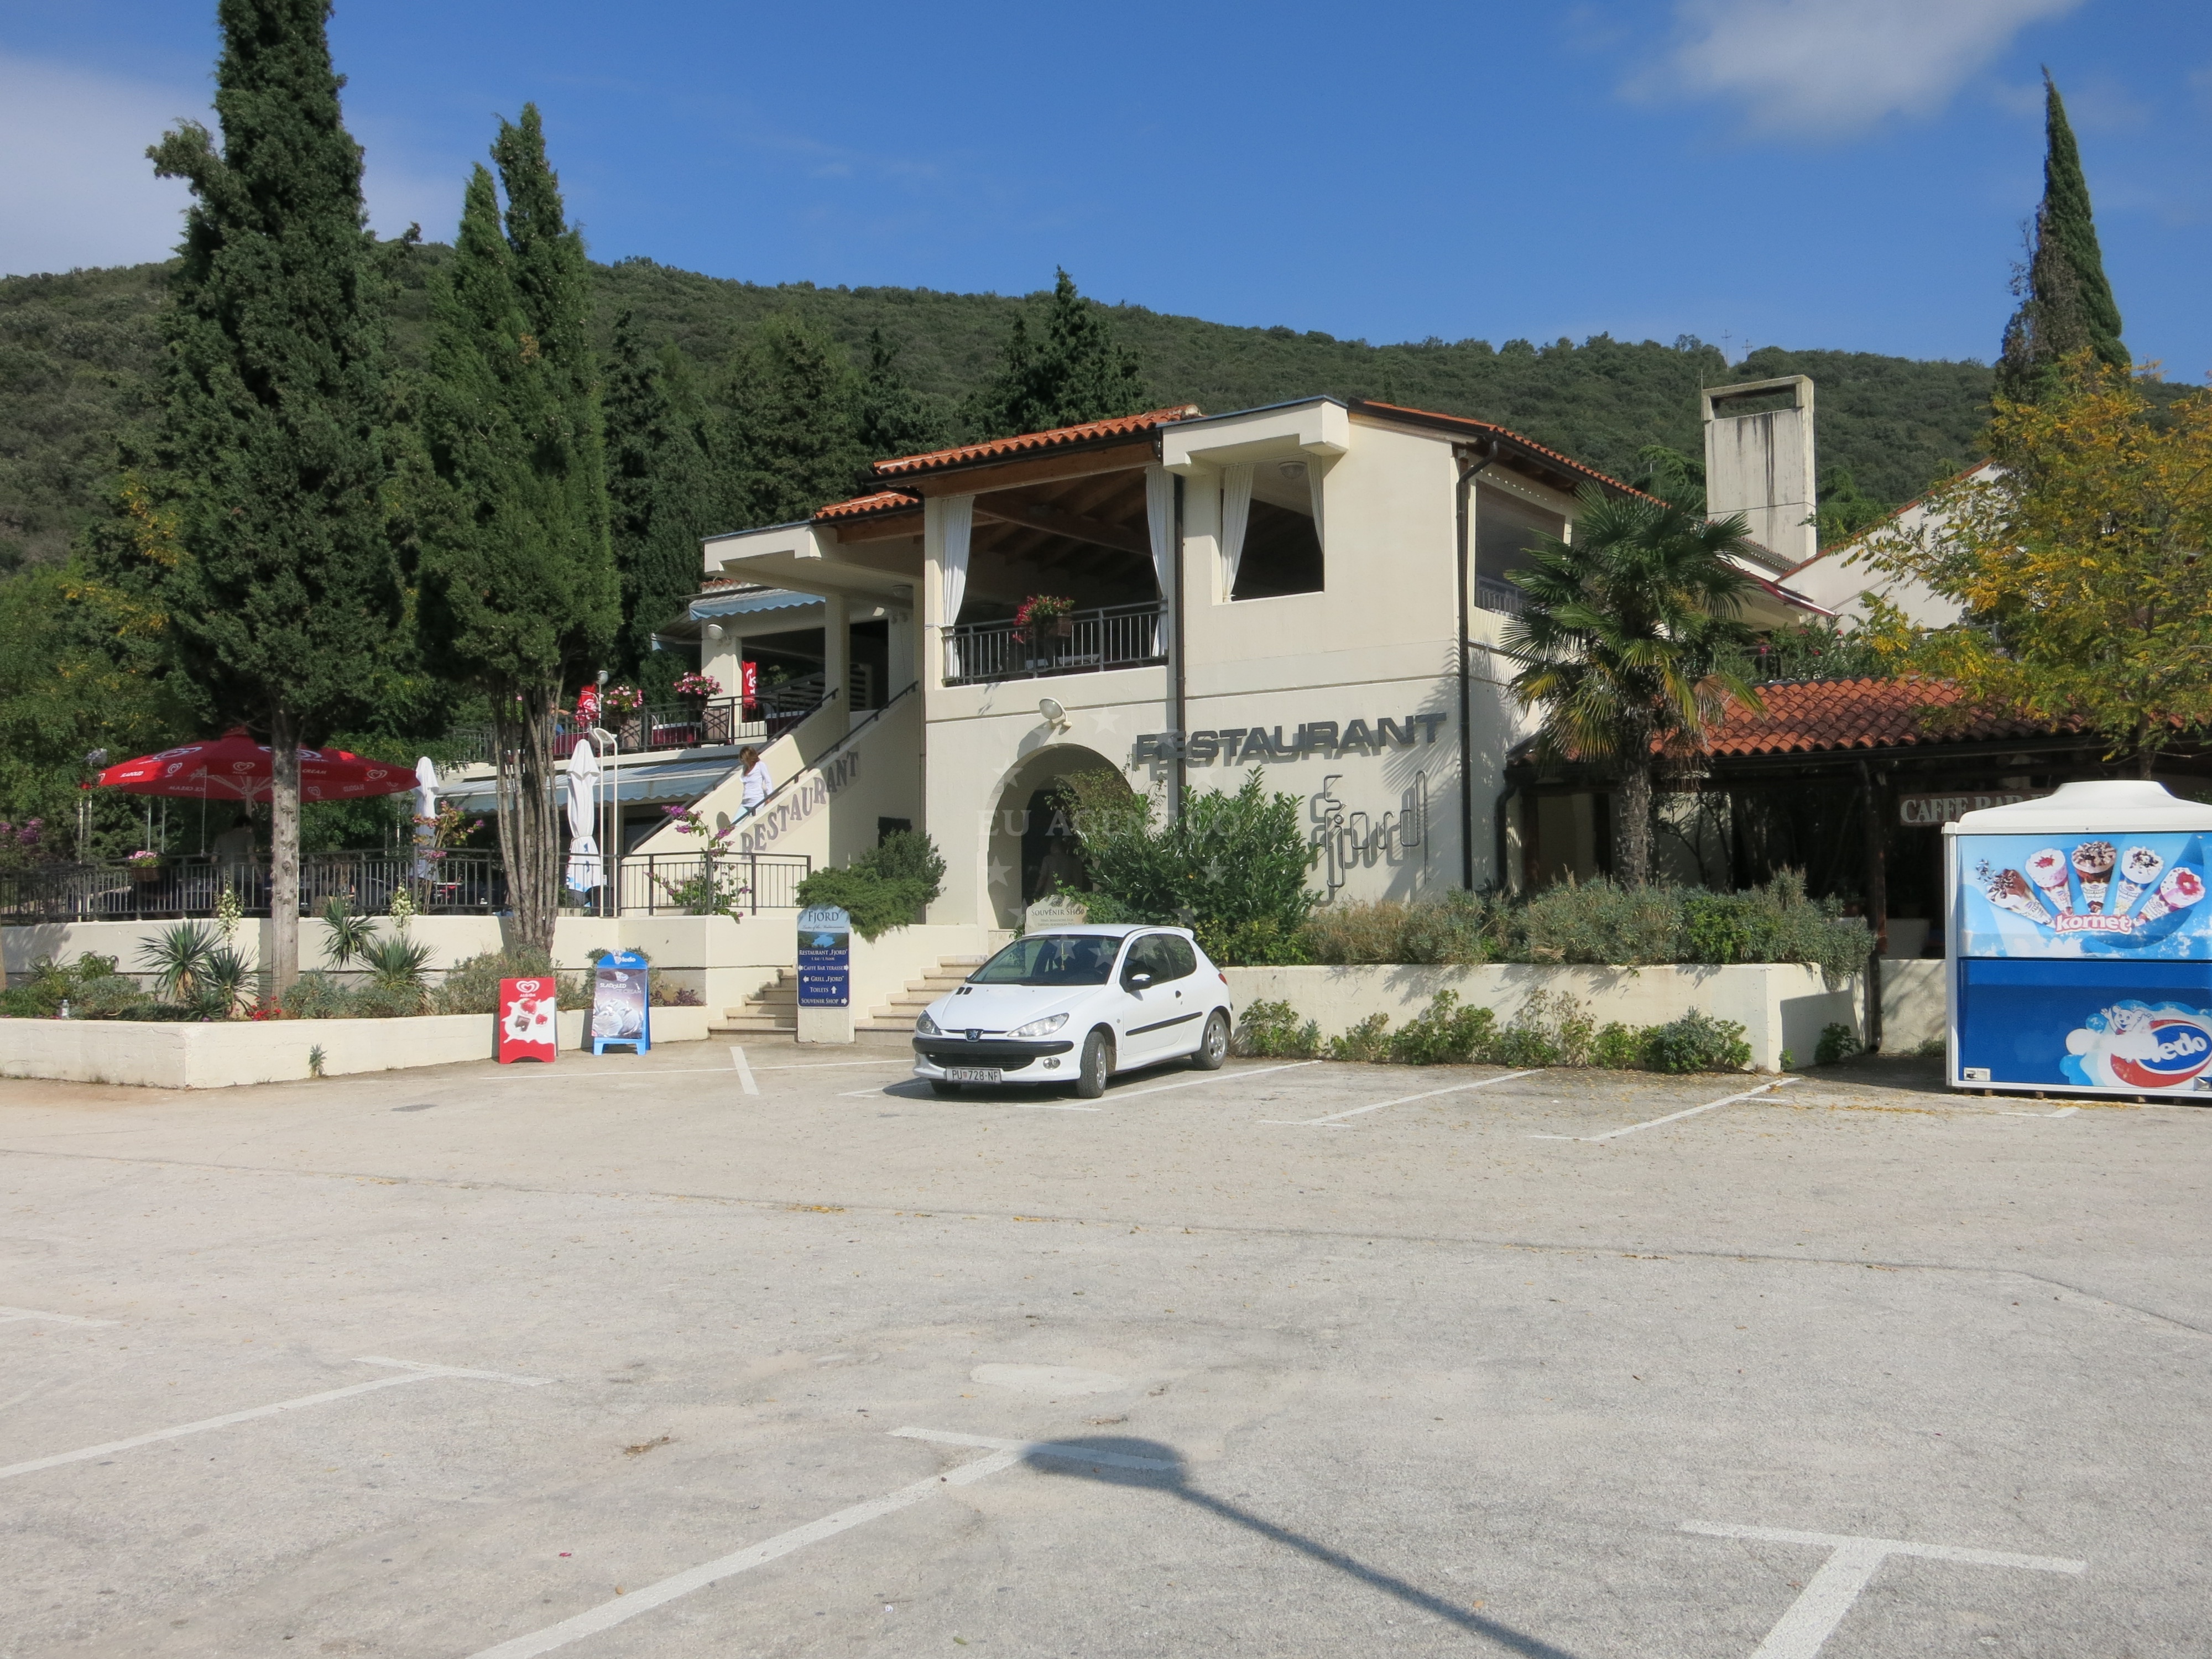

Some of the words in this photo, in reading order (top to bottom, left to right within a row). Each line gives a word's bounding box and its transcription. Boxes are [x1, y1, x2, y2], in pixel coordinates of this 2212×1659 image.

[1136, 712, 1447, 762] RESTAURANT
[741, 750, 859, 860] RESTAURANT
[1901, 797, 1969, 823] CAFFE
[808, 910, 839, 924] FJORD
[2055, 913, 2130, 932] kornet
[952, 1070, 963, 1080] PU
